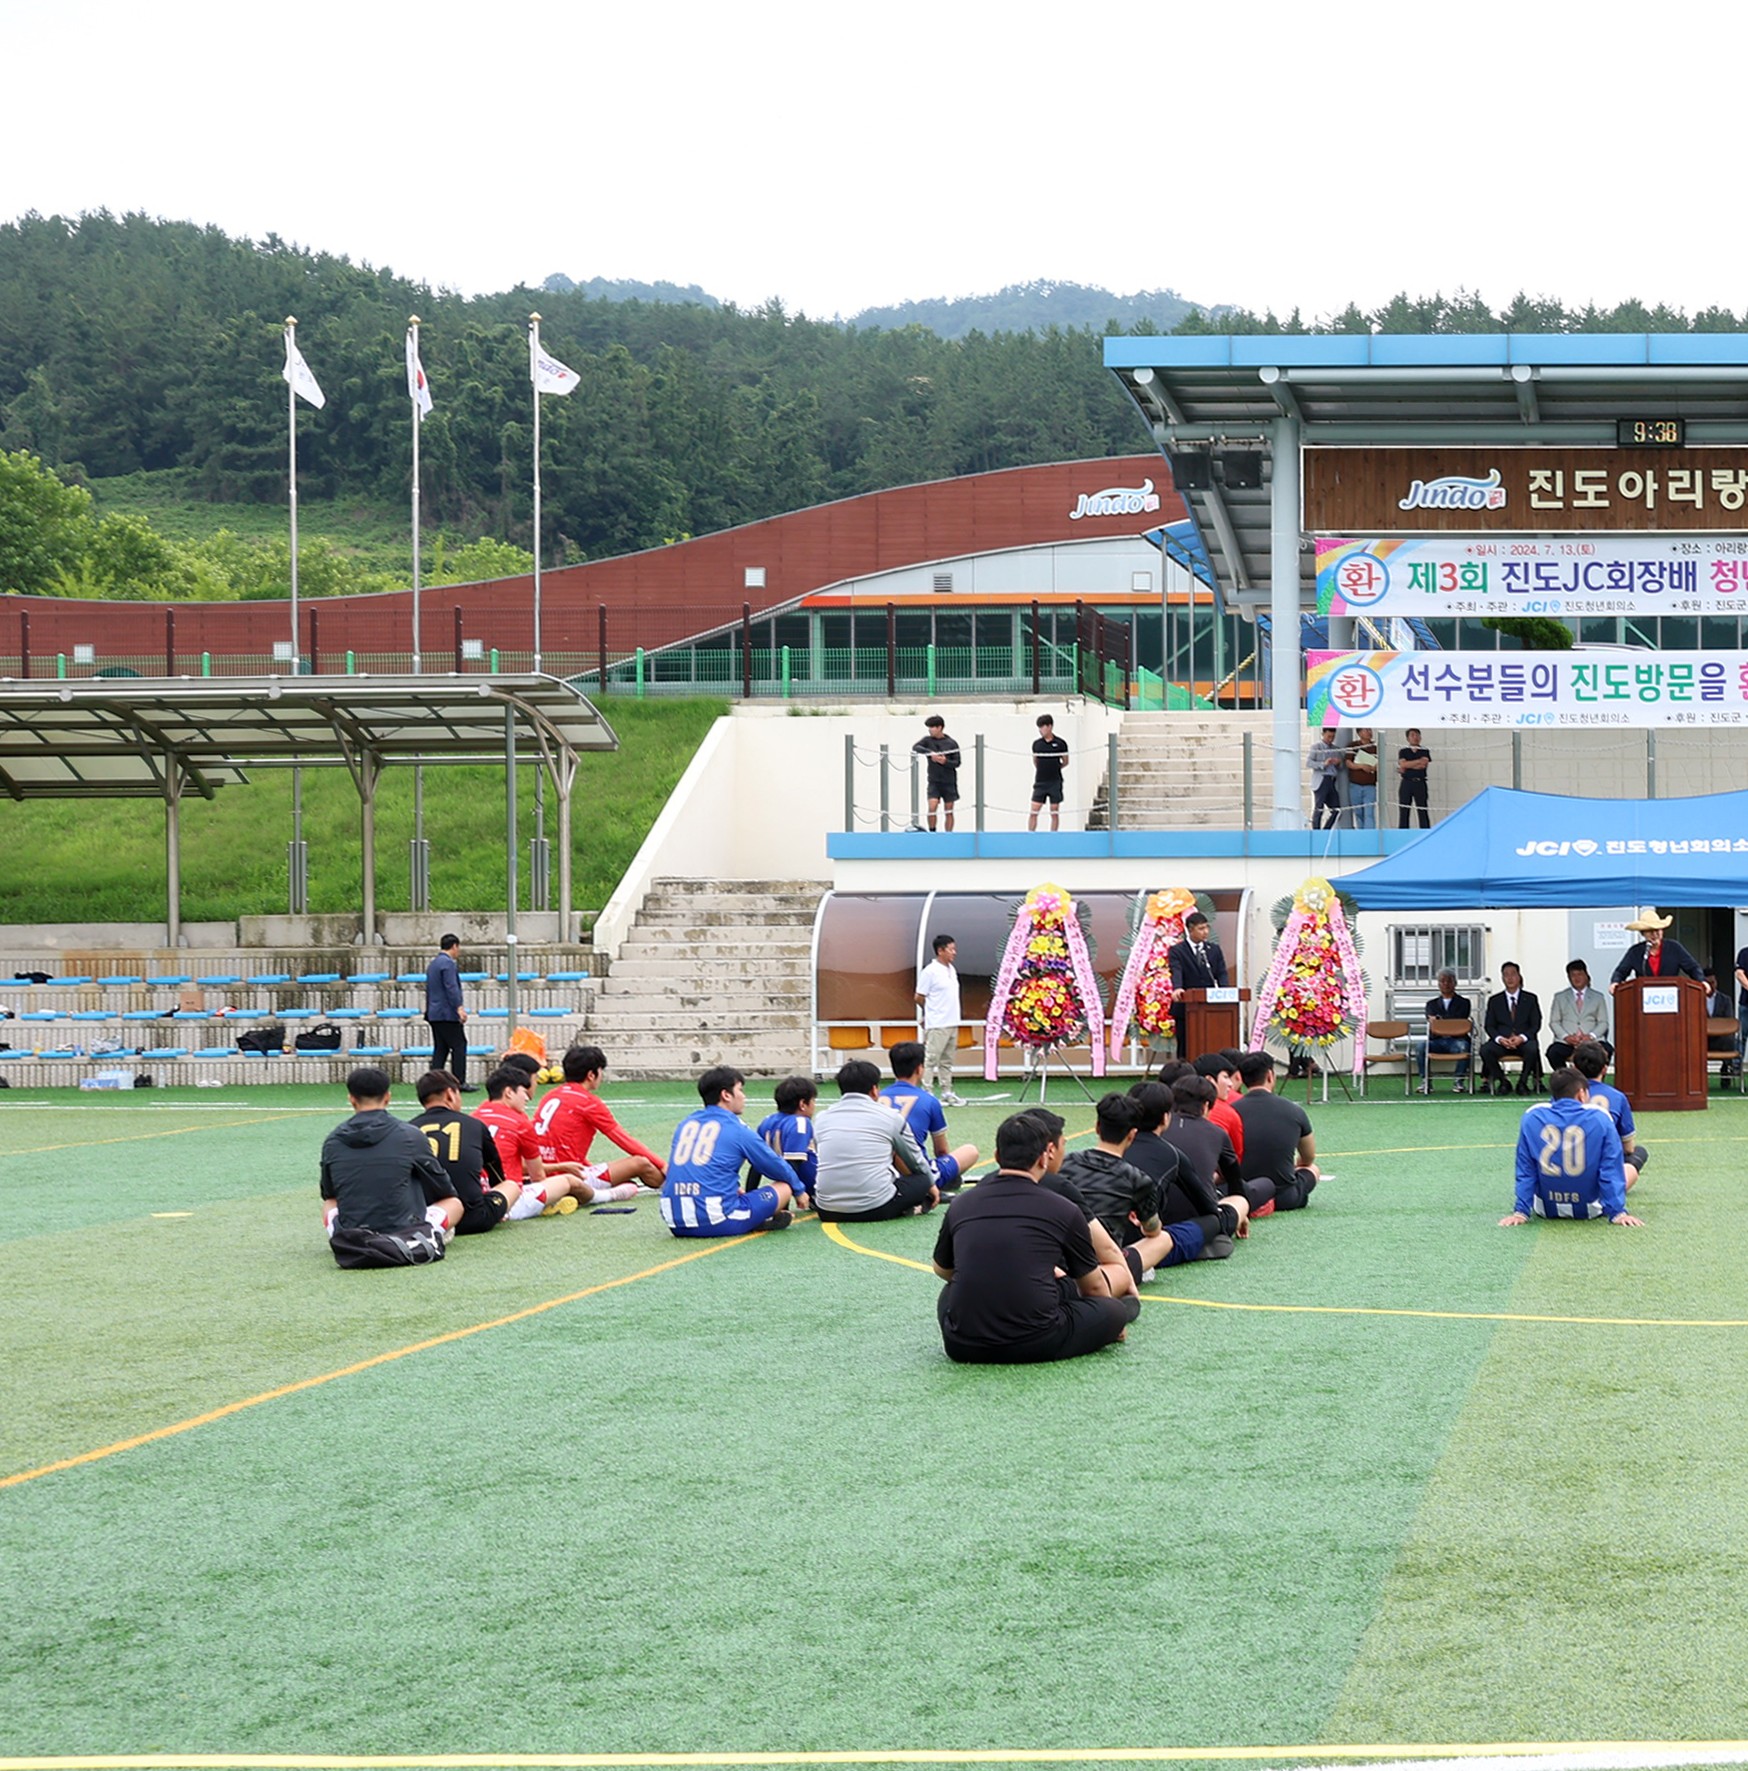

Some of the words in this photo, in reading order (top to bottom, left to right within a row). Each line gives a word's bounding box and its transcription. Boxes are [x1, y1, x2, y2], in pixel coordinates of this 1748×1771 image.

[1399, 479, 1488, 509] Jindo
[1475, 545, 1498, 556] 일시
[1510, 544, 1541, 556] 2024.
[1544, 545, 1556, 556] 7.
[1559, 544, 1597, 557] 13.(토)
[1680, 542, 1701, 554] 장소
[1340, 561, 1382, 598] 환
[1407, 561, 1489, 595] 제3회
[1500, 560, 1698, 594] 진도JC회장배
[1521, 601, 1548, 612] JCI
[1564, 601, 1636, 612] 진도청년회의소
[1680, 599, 1702, 611] 후원
[1401, 663, 1558, 702] 선수분들의
[1570, 662, 1727, 701] 진도방문을
[1335, 674, 1376, 708] 환
[1515, 713, 1543, 725] JCI
[1558, 713, 1630, 724] 진도청년회의소
[1675, 712, 1696, 723] 후원
[1516, 841, 1571, 856] JCI
[1209, 989, 1228, 999] JCI
[1643, 994, 1665, 1005] JCI
[534, 1098, 561, 1136] 9
[673, 1120, 722, 1166] 88
[1540, 1124, 1586, 1177] 20
[674, 1182, 700, 1196] IDFS
[1549, 1191, 1580, 1203] IDFS
